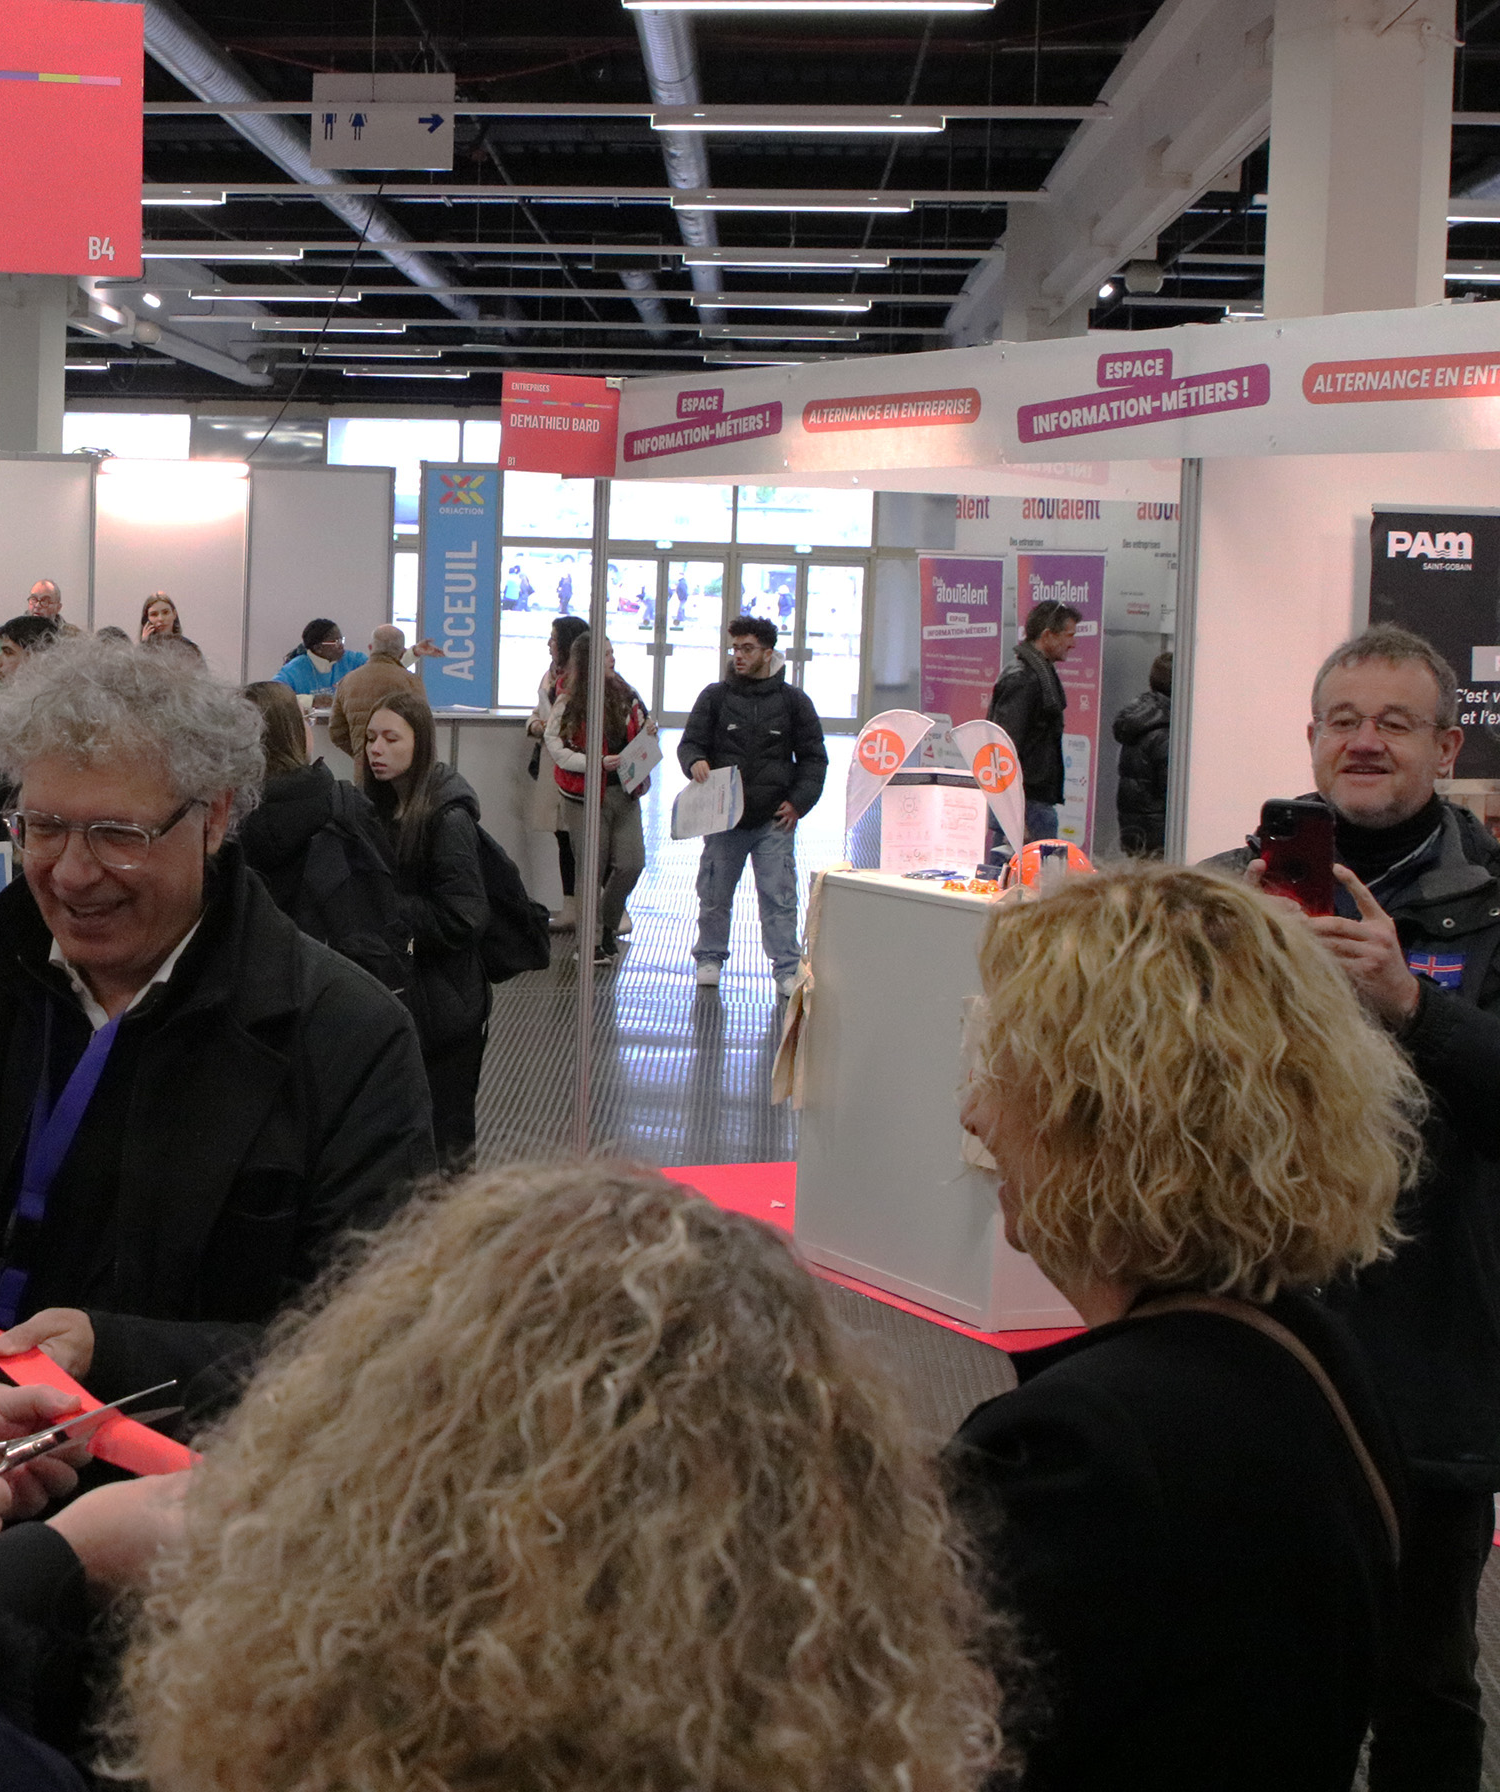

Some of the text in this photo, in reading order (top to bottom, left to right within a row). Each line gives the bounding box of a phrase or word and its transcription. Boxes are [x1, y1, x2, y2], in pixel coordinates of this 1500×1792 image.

[88, 236, 115, 262] B4
[1105, 358, 1163, 380] ESPACE
[511, 382, 550, 393] ENTREPRISES
[1312, 368, 1431, 394] ALTERNANCE
[1434, 366, 1461, 387] EN
[682, 396, 719, 413] ESPACE
[808, 398, 972, 425] ALTERNANCE EN ENTREPRISE
[1032, 380, 1237, 434] INFORMATION-MÉTIERS
[510, 413, 600, 433] DEMATHIEU BARD
[633, 414, 764, 456] INFORMATION-MÉTIERS
[507, 456, 516, 466] B1
[439, 507, 484, 516] ORIACTION
[1422, 562, 1472, 571] SAINT-GOBAIN
[932, 576, 944, 587] Club
[1029, 573, 1041, 585] Club
[936, 582, 989, 605] atouTalent
[442, 541, 479, 682] ACCEUIL
[1461, 710, 1477, 725] et
